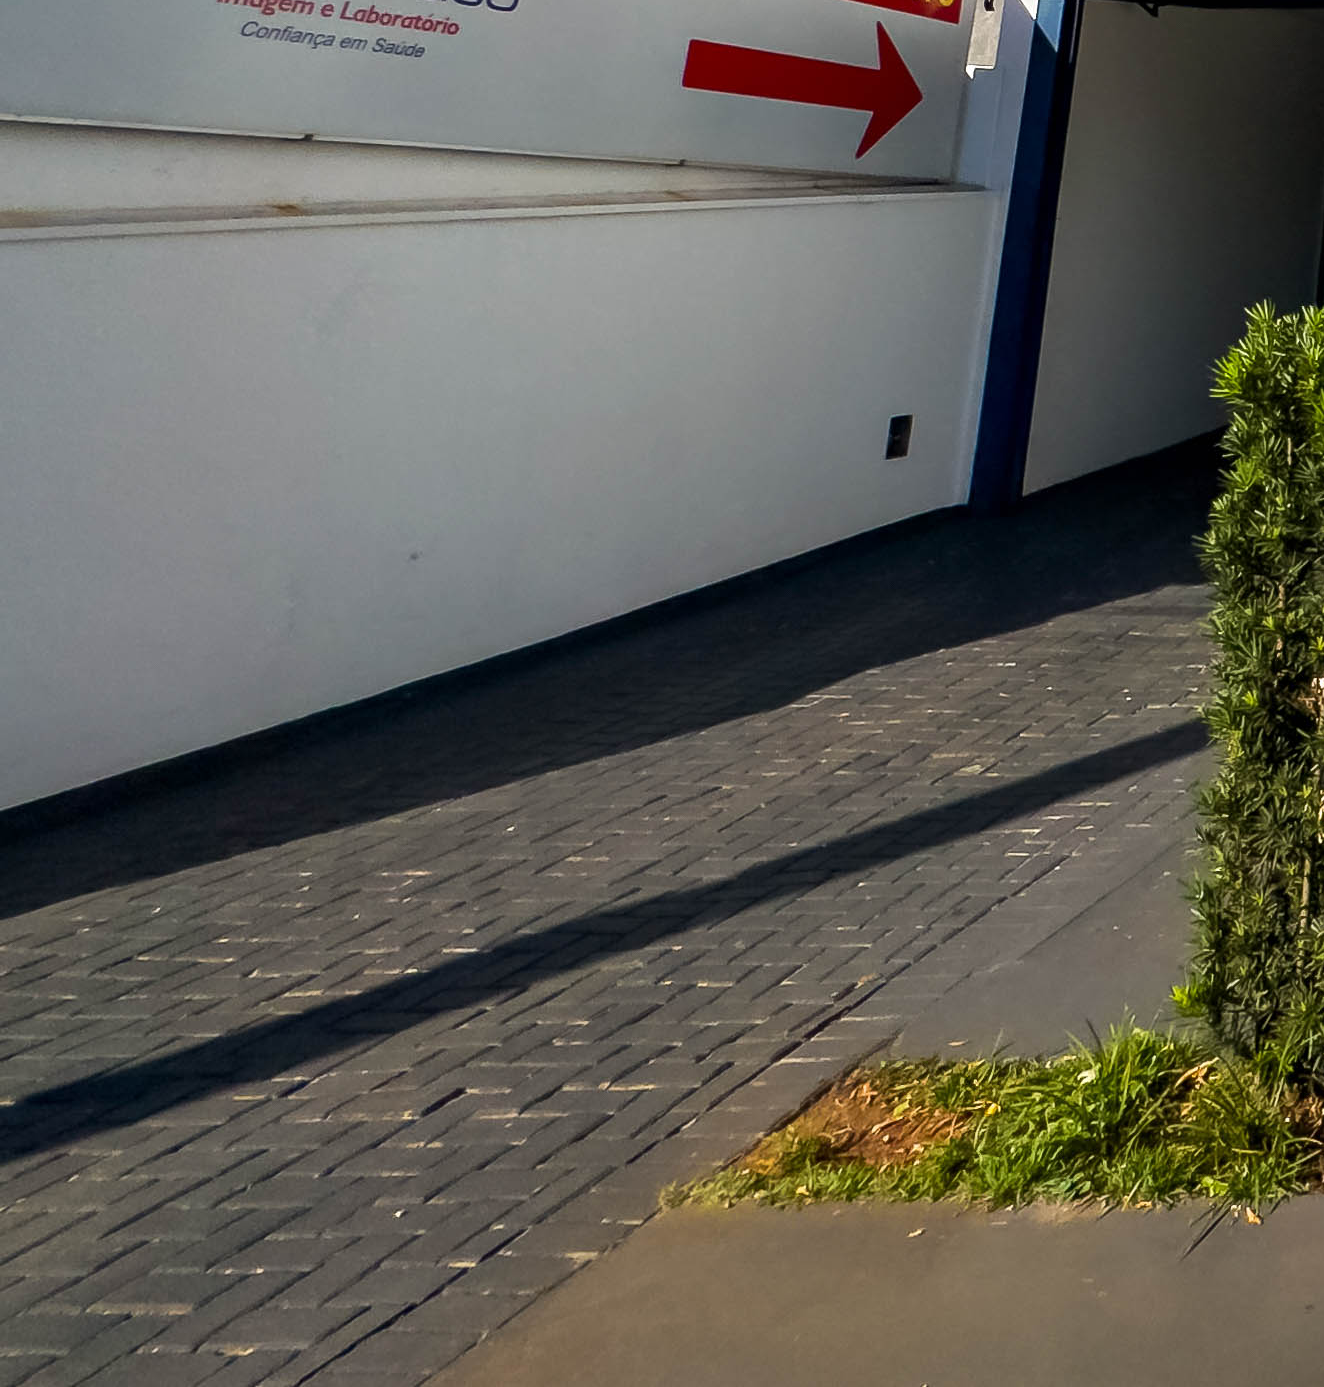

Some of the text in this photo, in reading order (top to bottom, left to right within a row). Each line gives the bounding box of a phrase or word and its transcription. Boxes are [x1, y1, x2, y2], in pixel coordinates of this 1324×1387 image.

[320, 3, 334, 17] e
[340, 0, 461, 36] Laboratório
[240, 20, 426, 58] Confiança em Saúde
